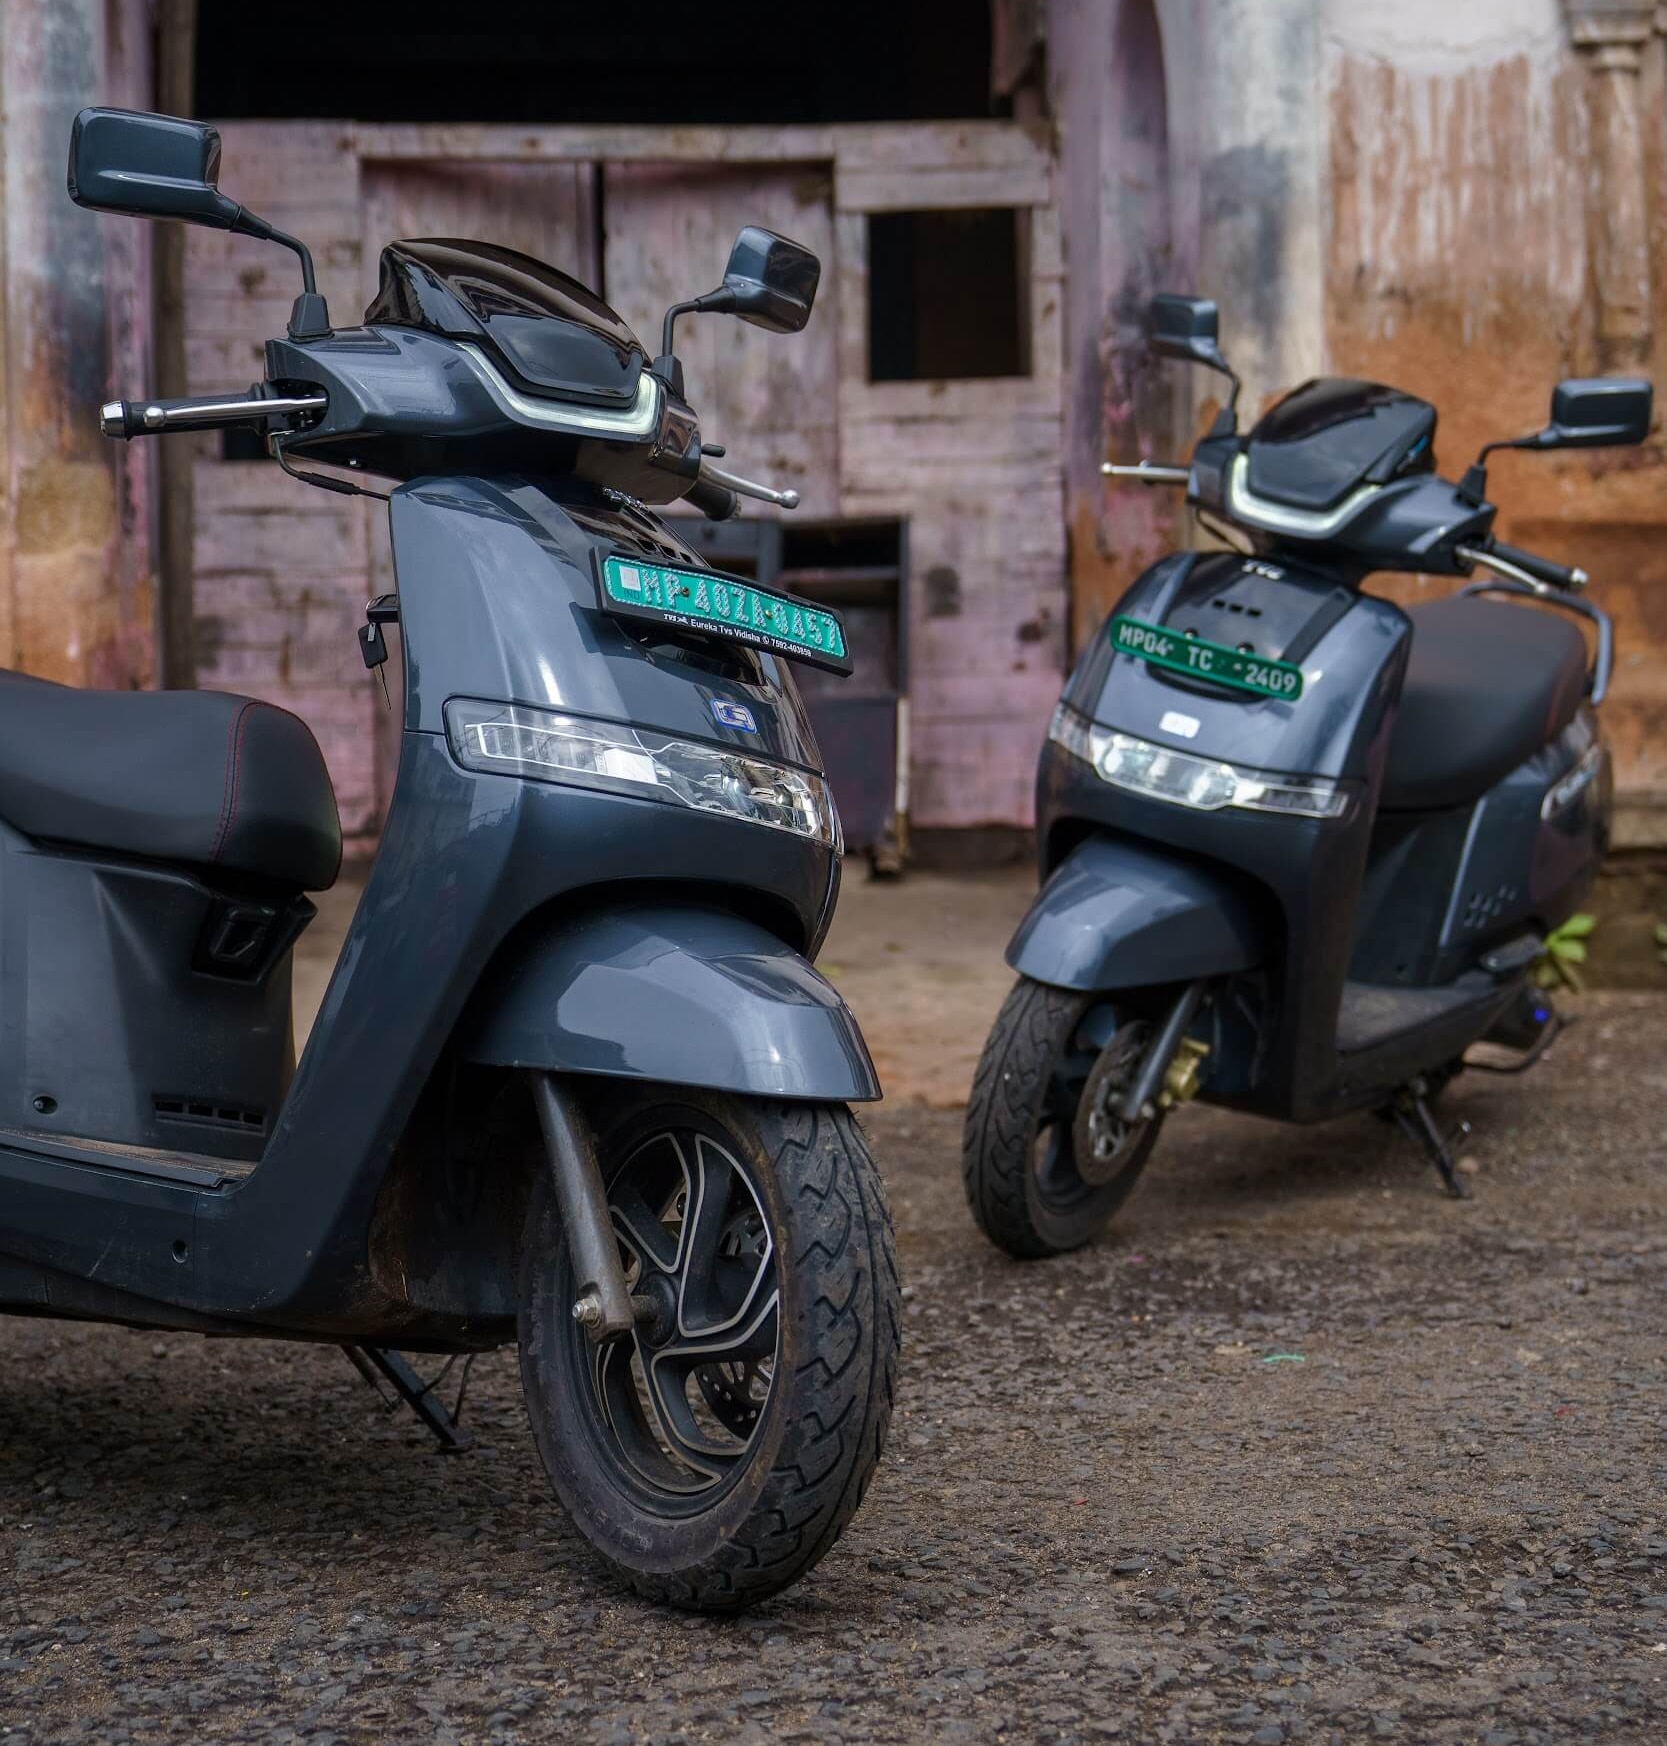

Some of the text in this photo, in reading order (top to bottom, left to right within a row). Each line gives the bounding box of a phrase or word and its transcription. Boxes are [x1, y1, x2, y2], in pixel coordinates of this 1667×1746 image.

[690, 618, 718, 633] Eureka
[719, 625, 733, 636] Tvs
[734, 628, 761, 643] Vidisha
[1119, 623, 1297, 694] MP04 TC 2409
